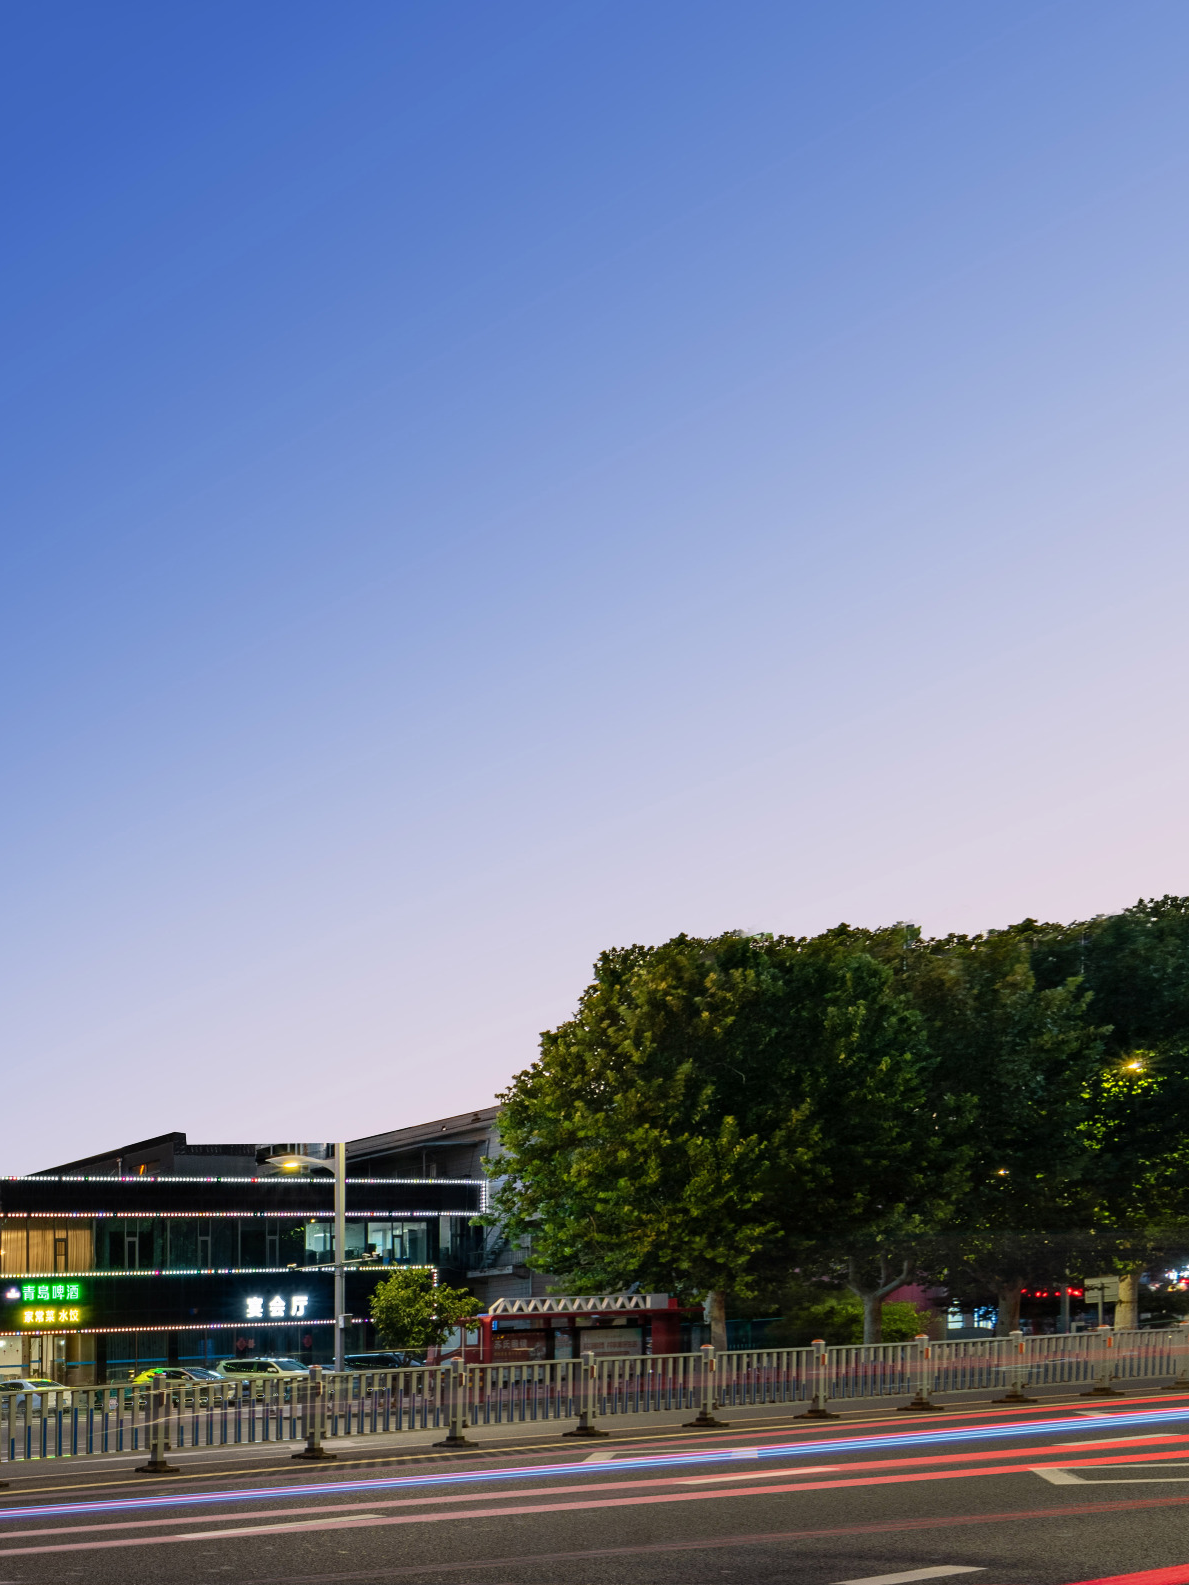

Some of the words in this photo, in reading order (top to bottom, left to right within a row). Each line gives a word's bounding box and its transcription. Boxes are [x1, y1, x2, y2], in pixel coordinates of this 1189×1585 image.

[23, 1284, 79, 1301] 青岛啤酒
[246, 1295, 309, 1318] 宴会厅
[23, 1310, 55, 1323] 家常菜
[58, 1309, 79, 1322] 水饺
